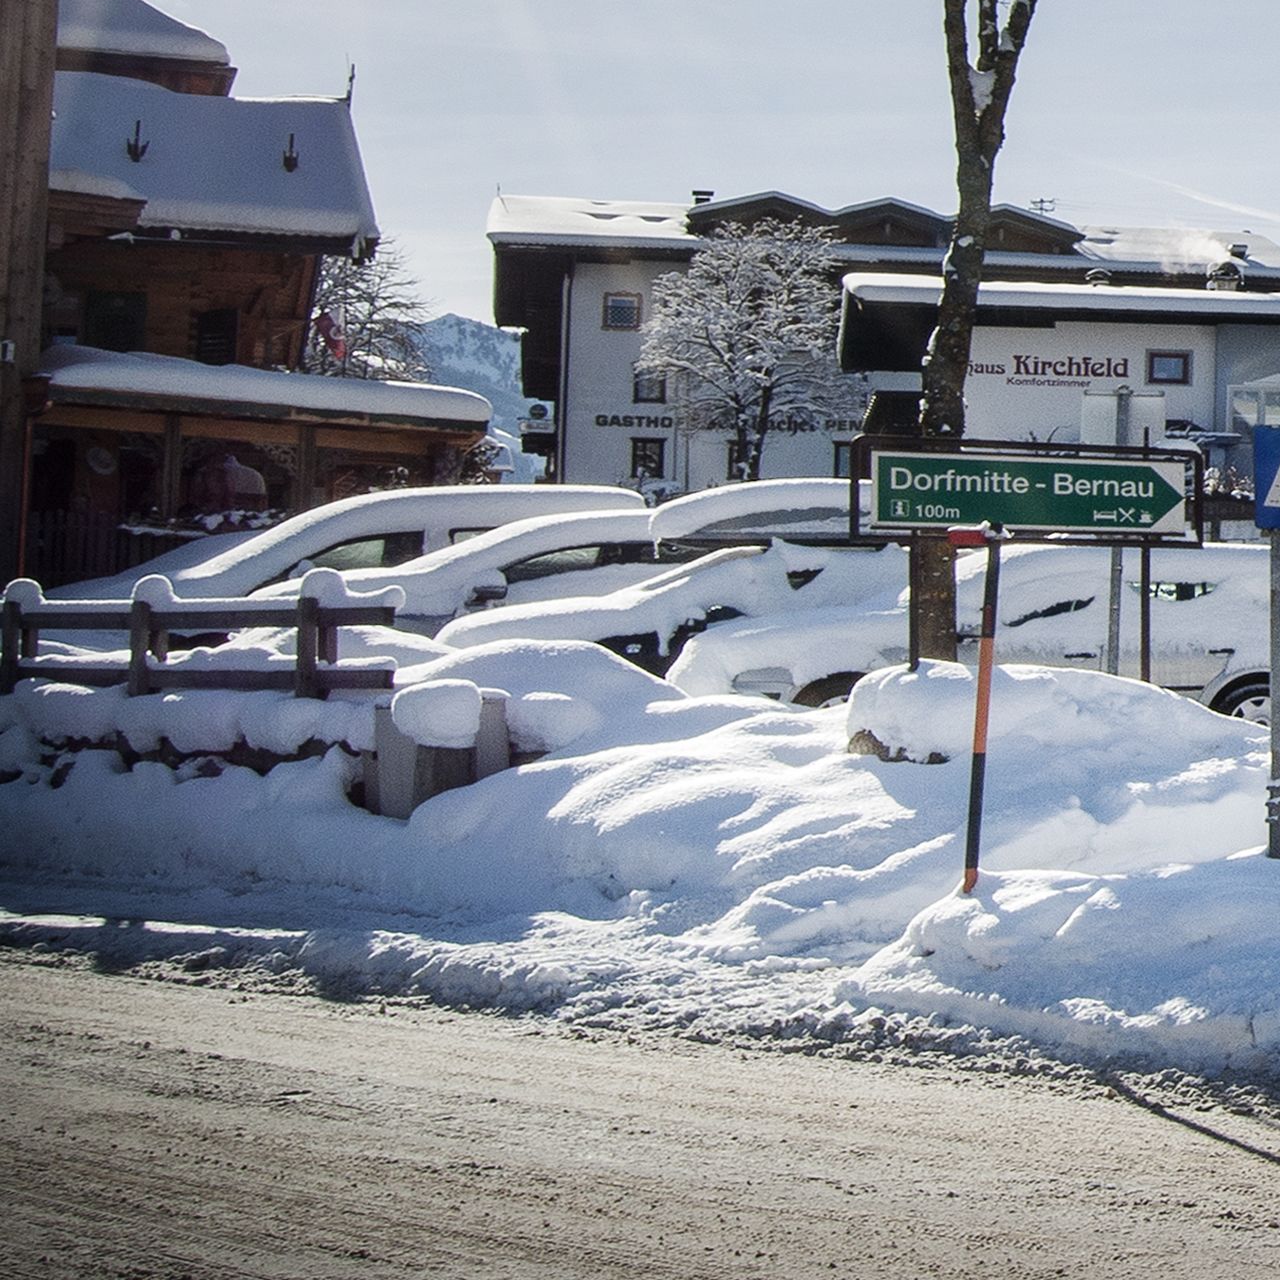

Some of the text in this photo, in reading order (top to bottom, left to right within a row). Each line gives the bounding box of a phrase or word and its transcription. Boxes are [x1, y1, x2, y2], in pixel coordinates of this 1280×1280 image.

[967, 354, 1129, 378] haus Kirchfeld
[1006, 376, 1092, 388] Komfortzimmer
[825, 420, 863, 431] PEN
[890, 466, 1030, 494] Dorfmitte
[1053, 472, 1154, 498] Bernau
[915, 505, 961, 519] 100m
